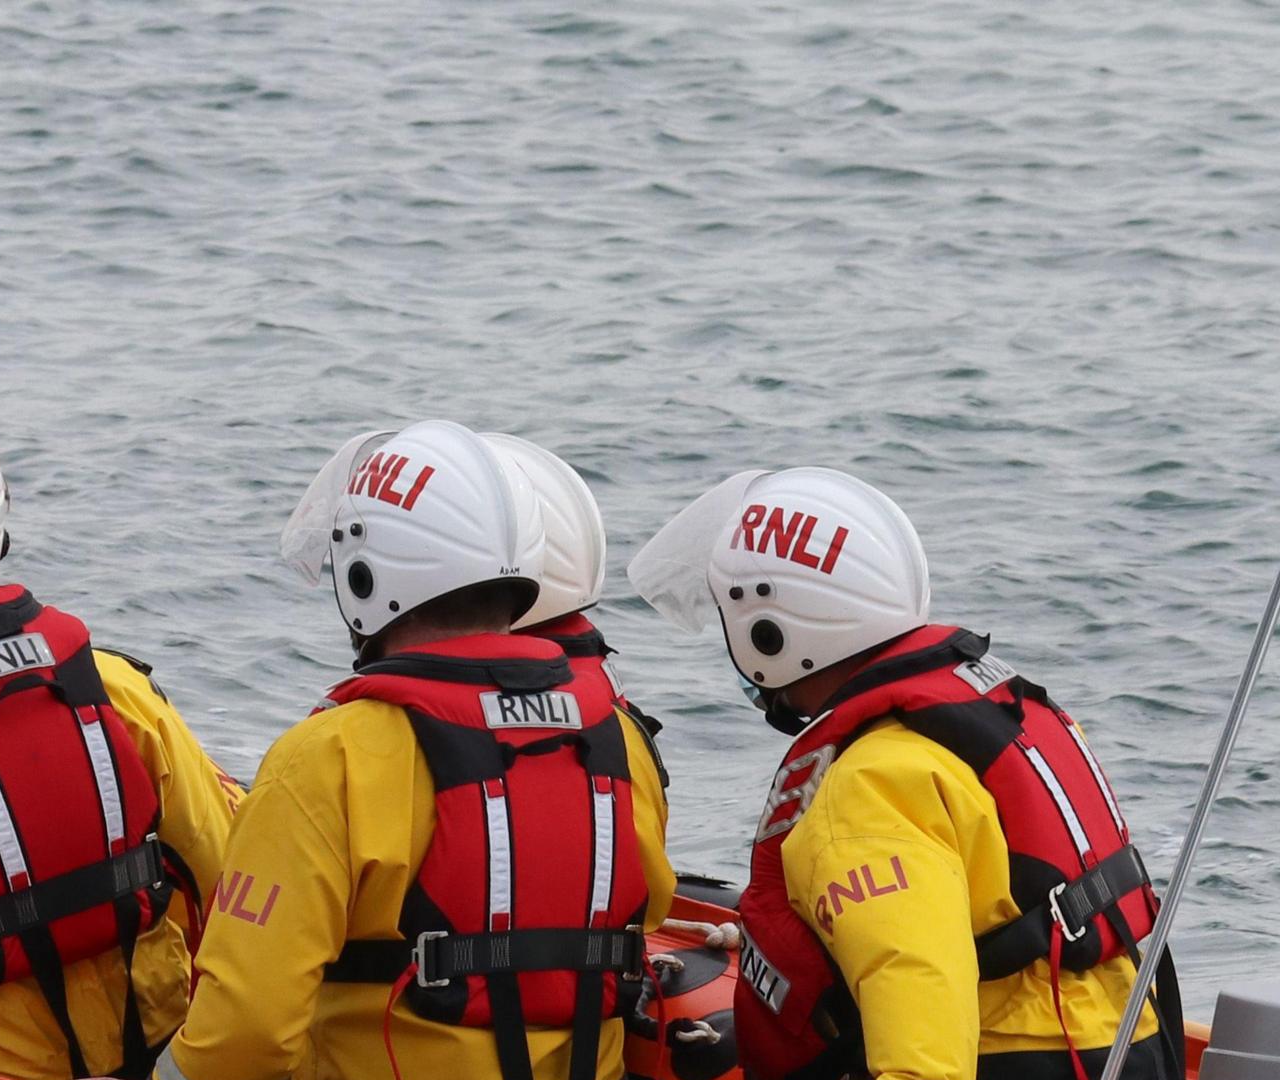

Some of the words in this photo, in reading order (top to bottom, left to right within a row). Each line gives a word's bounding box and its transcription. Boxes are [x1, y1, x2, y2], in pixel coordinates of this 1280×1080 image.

[729, 504, 850, 575] RNLI
[497, 693, 570, 723] RNLI
[218, 870, 281, 927] NLI
[815, 855, 909, 937] RNLI
